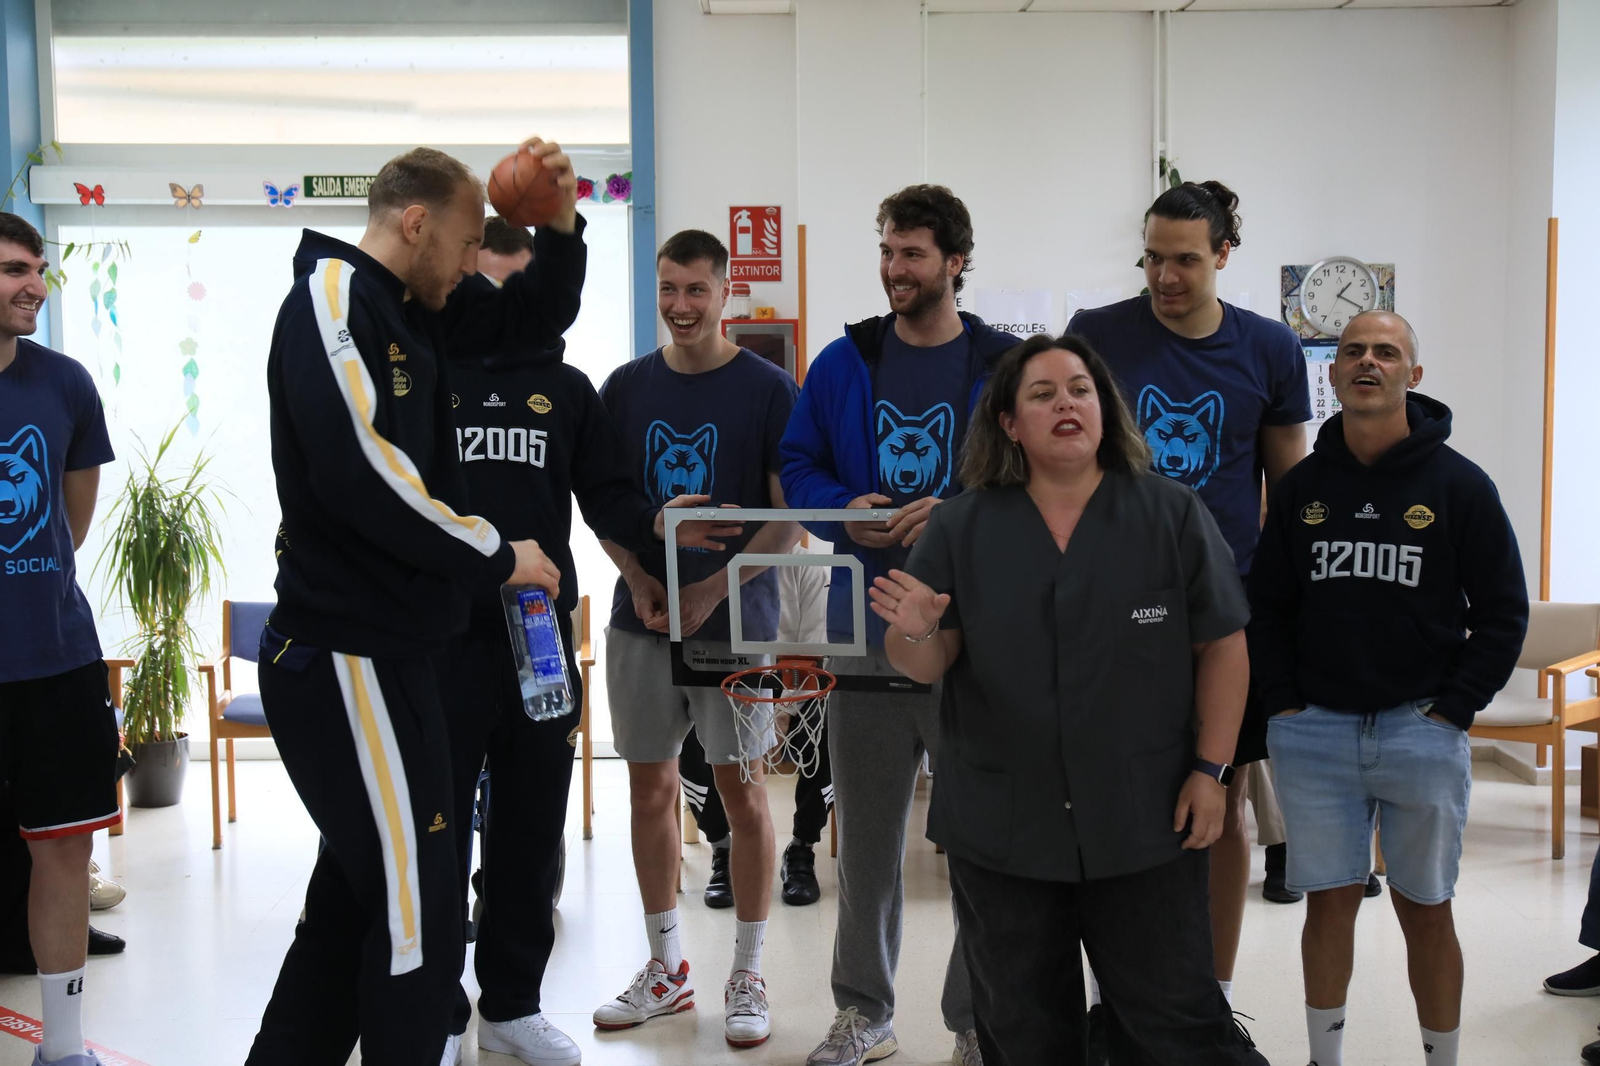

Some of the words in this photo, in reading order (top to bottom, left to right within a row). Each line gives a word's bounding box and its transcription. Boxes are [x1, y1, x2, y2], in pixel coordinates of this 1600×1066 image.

[312, 177, 342, 196] SALIDA
[732, 265, 780, 276] EXTINTOR
[1322, 269, 1331, 277] 11
[1335, 265, 1346, 274] 12
[1352, 269, 1356, 277] 1
[1312, 278, 1323, 286] 10
[1360, 279, 1367, 287] 2
[1363, 293, 1370, 301] 3
[1311, 305, 1318, 313] 8
[1321, 315, 1327, 323] 7
[1334, 319, 1342, 327] 6
[1318, 364, 1322, 373] 1
[1318, 376, 1323, 384] 8
[1317, 388, 1325, 396] 15
[1316, 399, 1325, 407] 22
[5, 557, 61, 575] SOCIAL
[1310, 540, 1423, 588] 32005
[1131, 605, 1168, 619] AIXIÑA
[737, 657, 750, 665] XL
